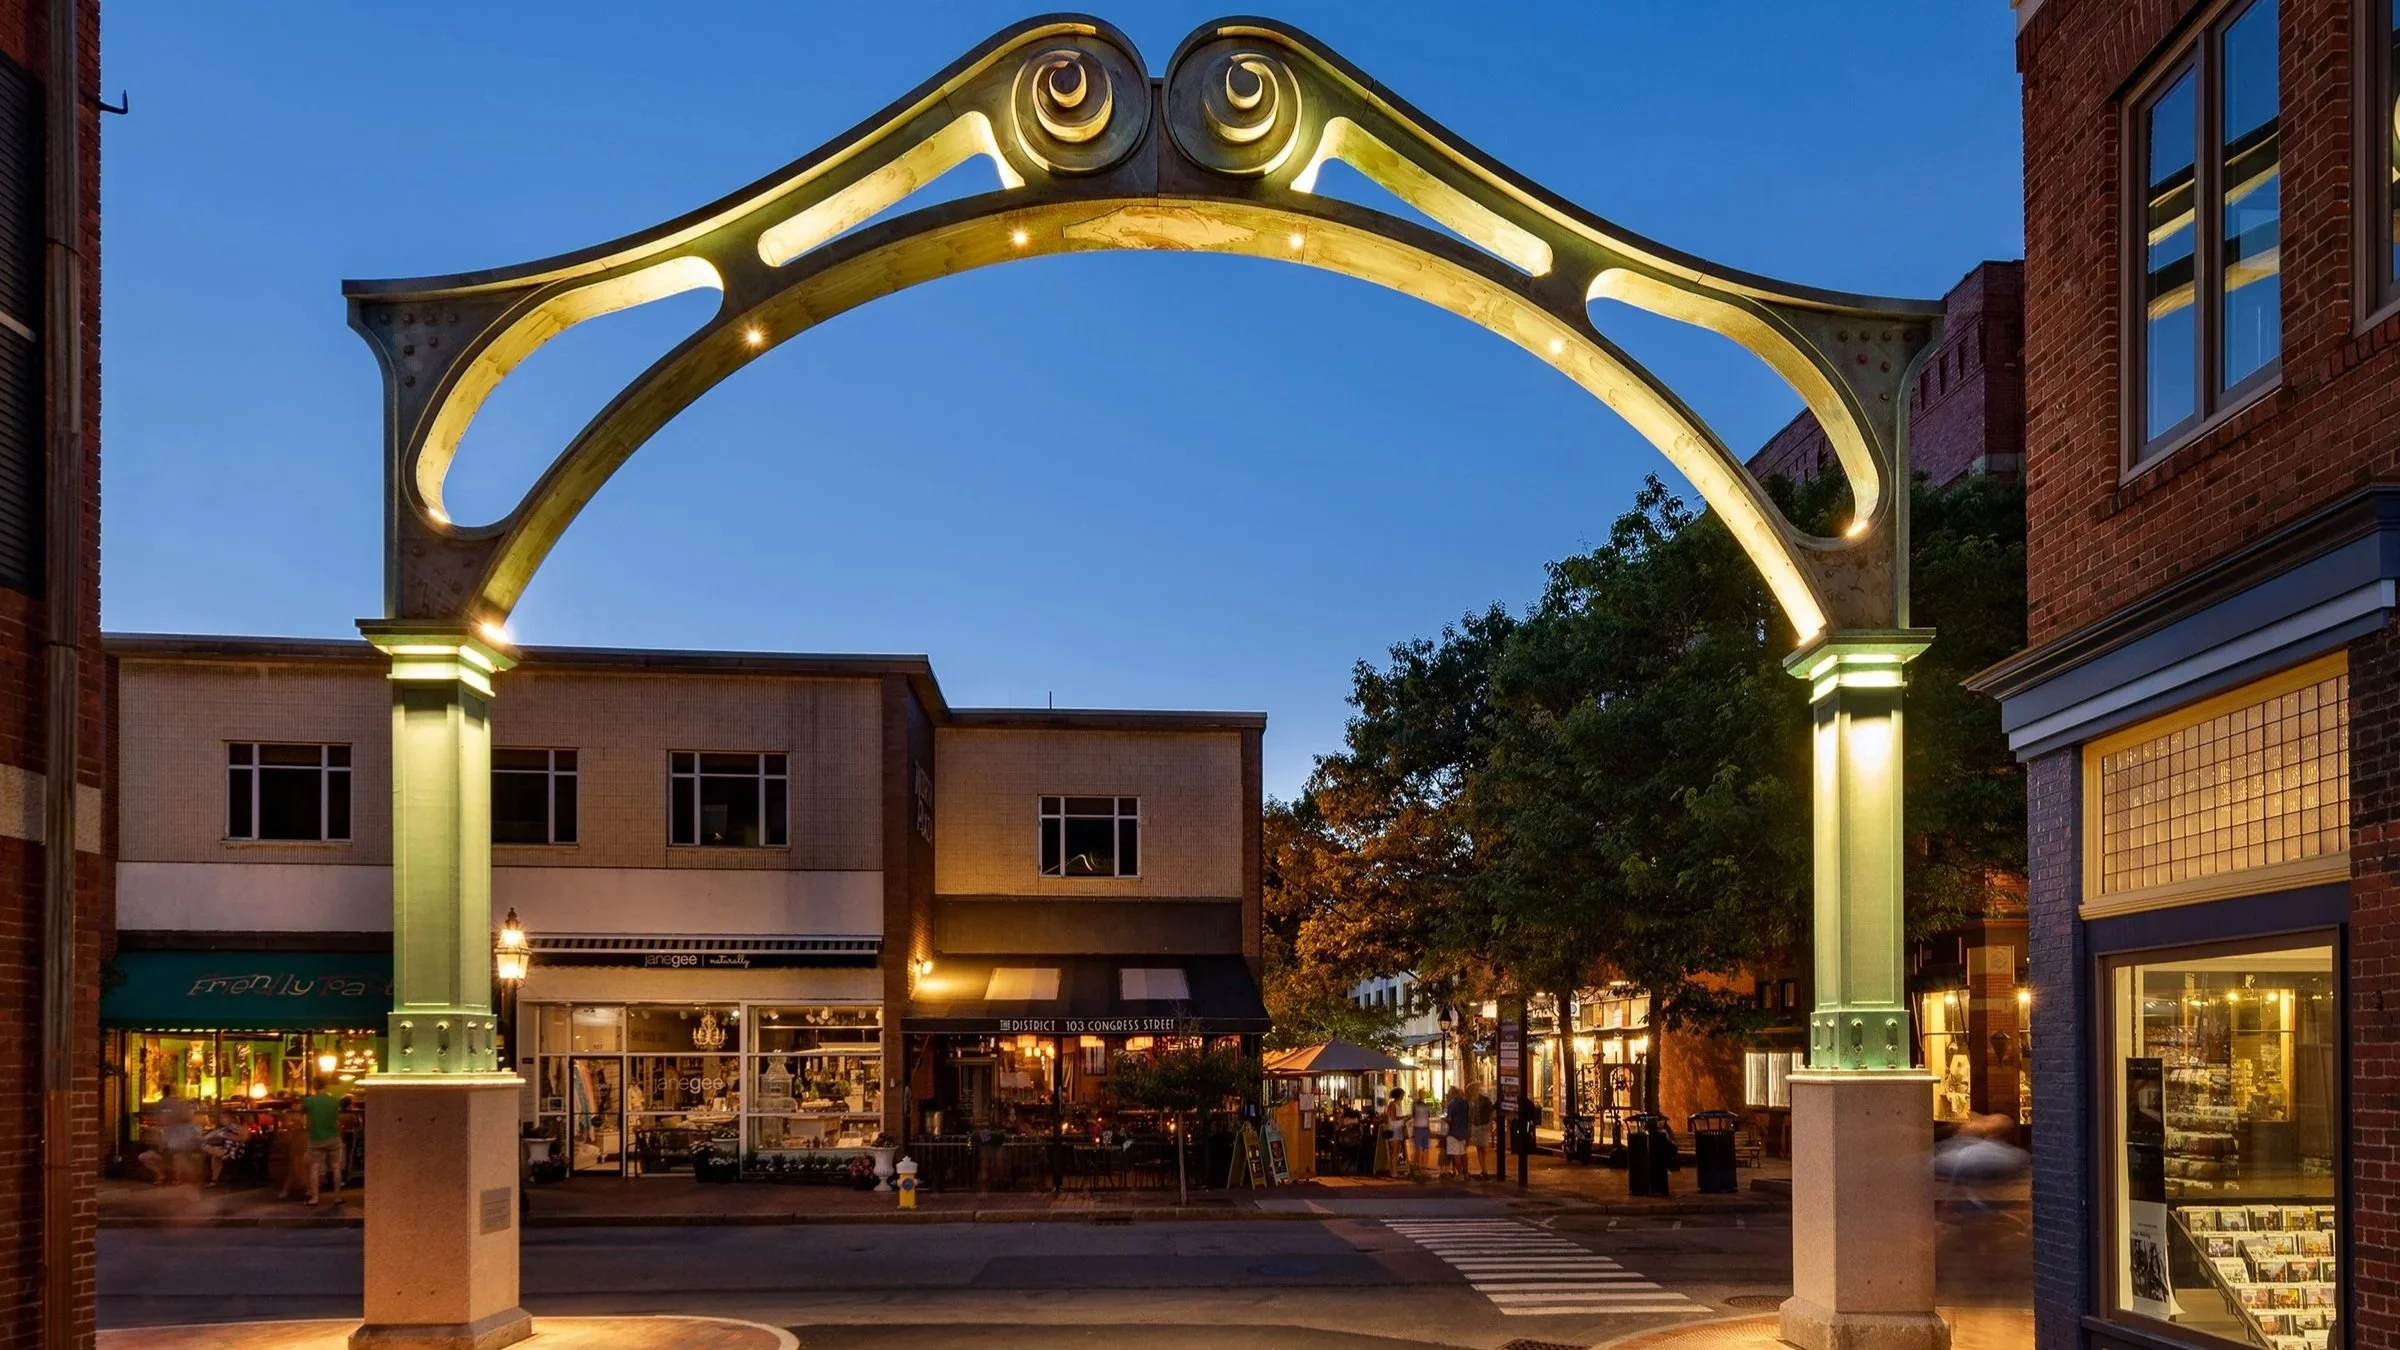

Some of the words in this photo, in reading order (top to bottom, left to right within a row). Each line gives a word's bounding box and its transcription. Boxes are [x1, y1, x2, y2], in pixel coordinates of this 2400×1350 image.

[644, 954, 698, 968] janegee
[709, 953, 751, 969] naturally
[316, 973, 394, 997] Toat
[1000, 1019, 1010, 1031] THE
[1012, 1019, 1056, 1032] DISTRICT
[1066, 1020, 1085, 1032] 103
[1087, 1019, 1139, 1032] CONGRESS
[1143, 1018, 1175, 1031] STREET
[652, 1076, 725, 1094] janegee
